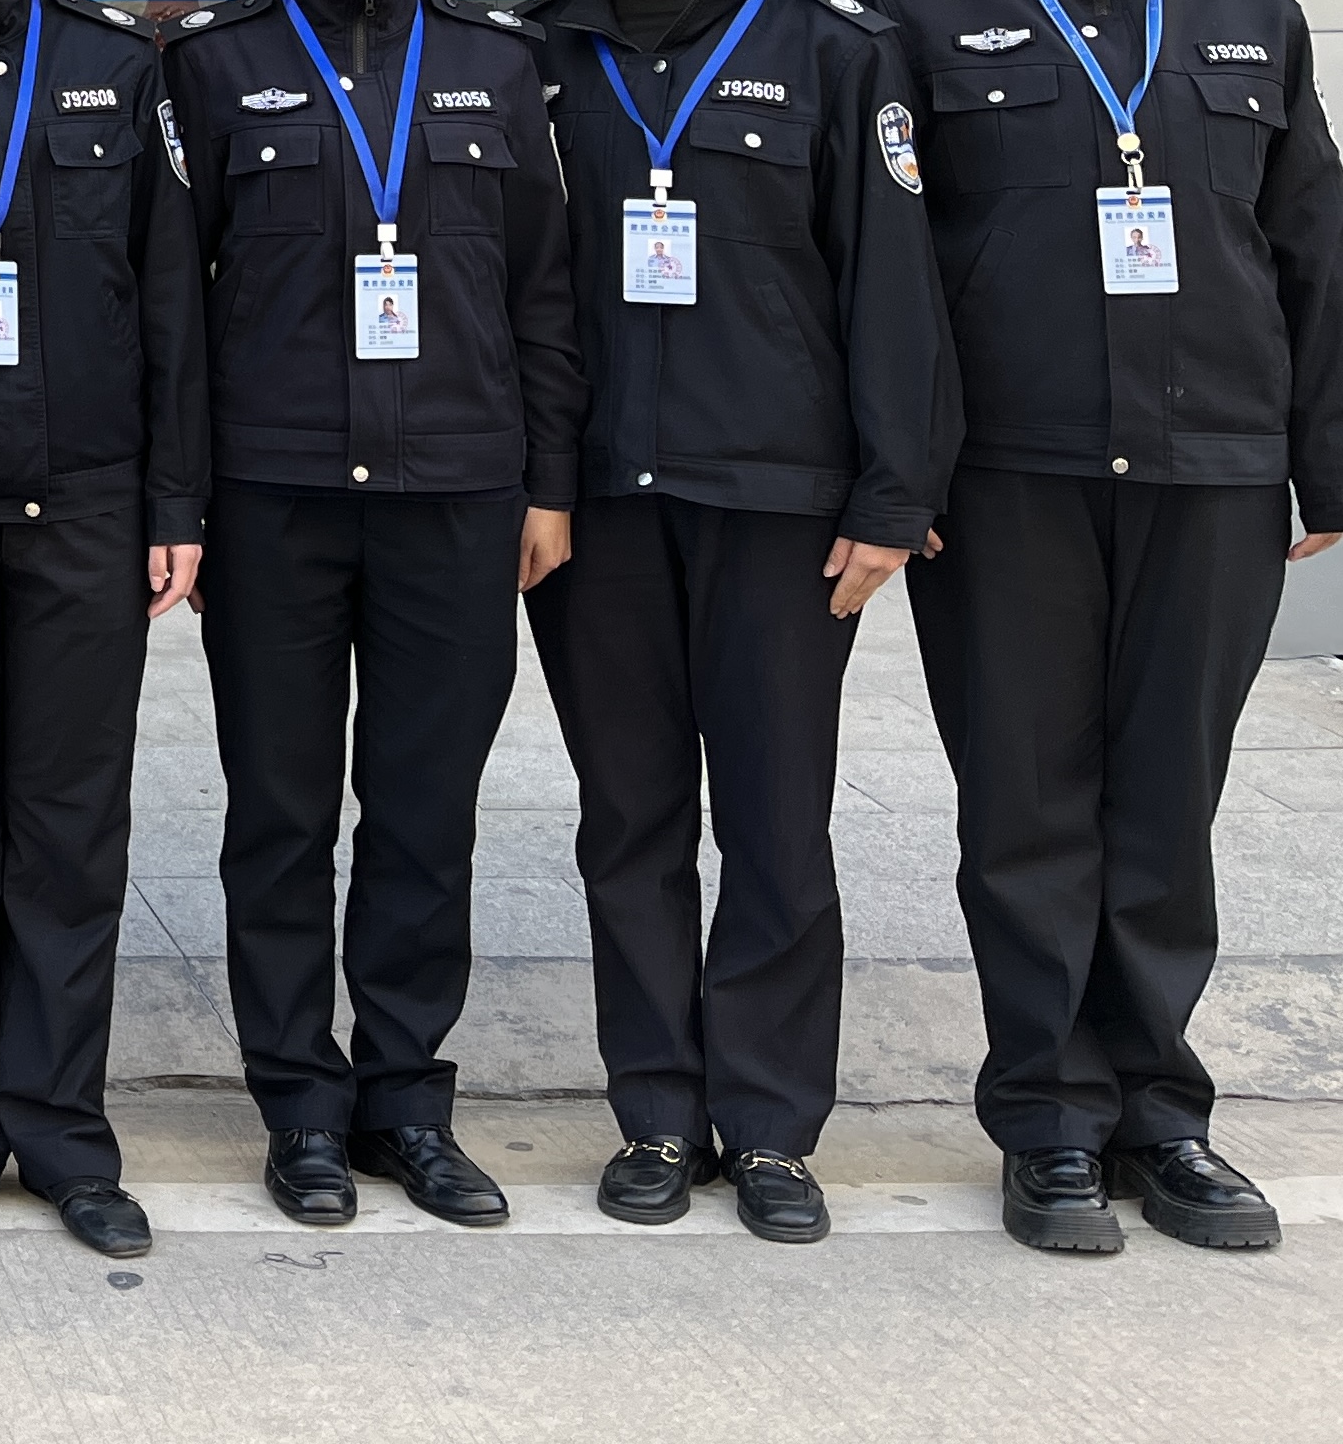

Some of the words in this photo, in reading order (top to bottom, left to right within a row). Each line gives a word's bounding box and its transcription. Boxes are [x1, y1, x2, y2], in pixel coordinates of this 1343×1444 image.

[61, 88, 117, 109] J92608
[432, 90, 492, 108] J92056
[718, 79, 785, 102] J92609
